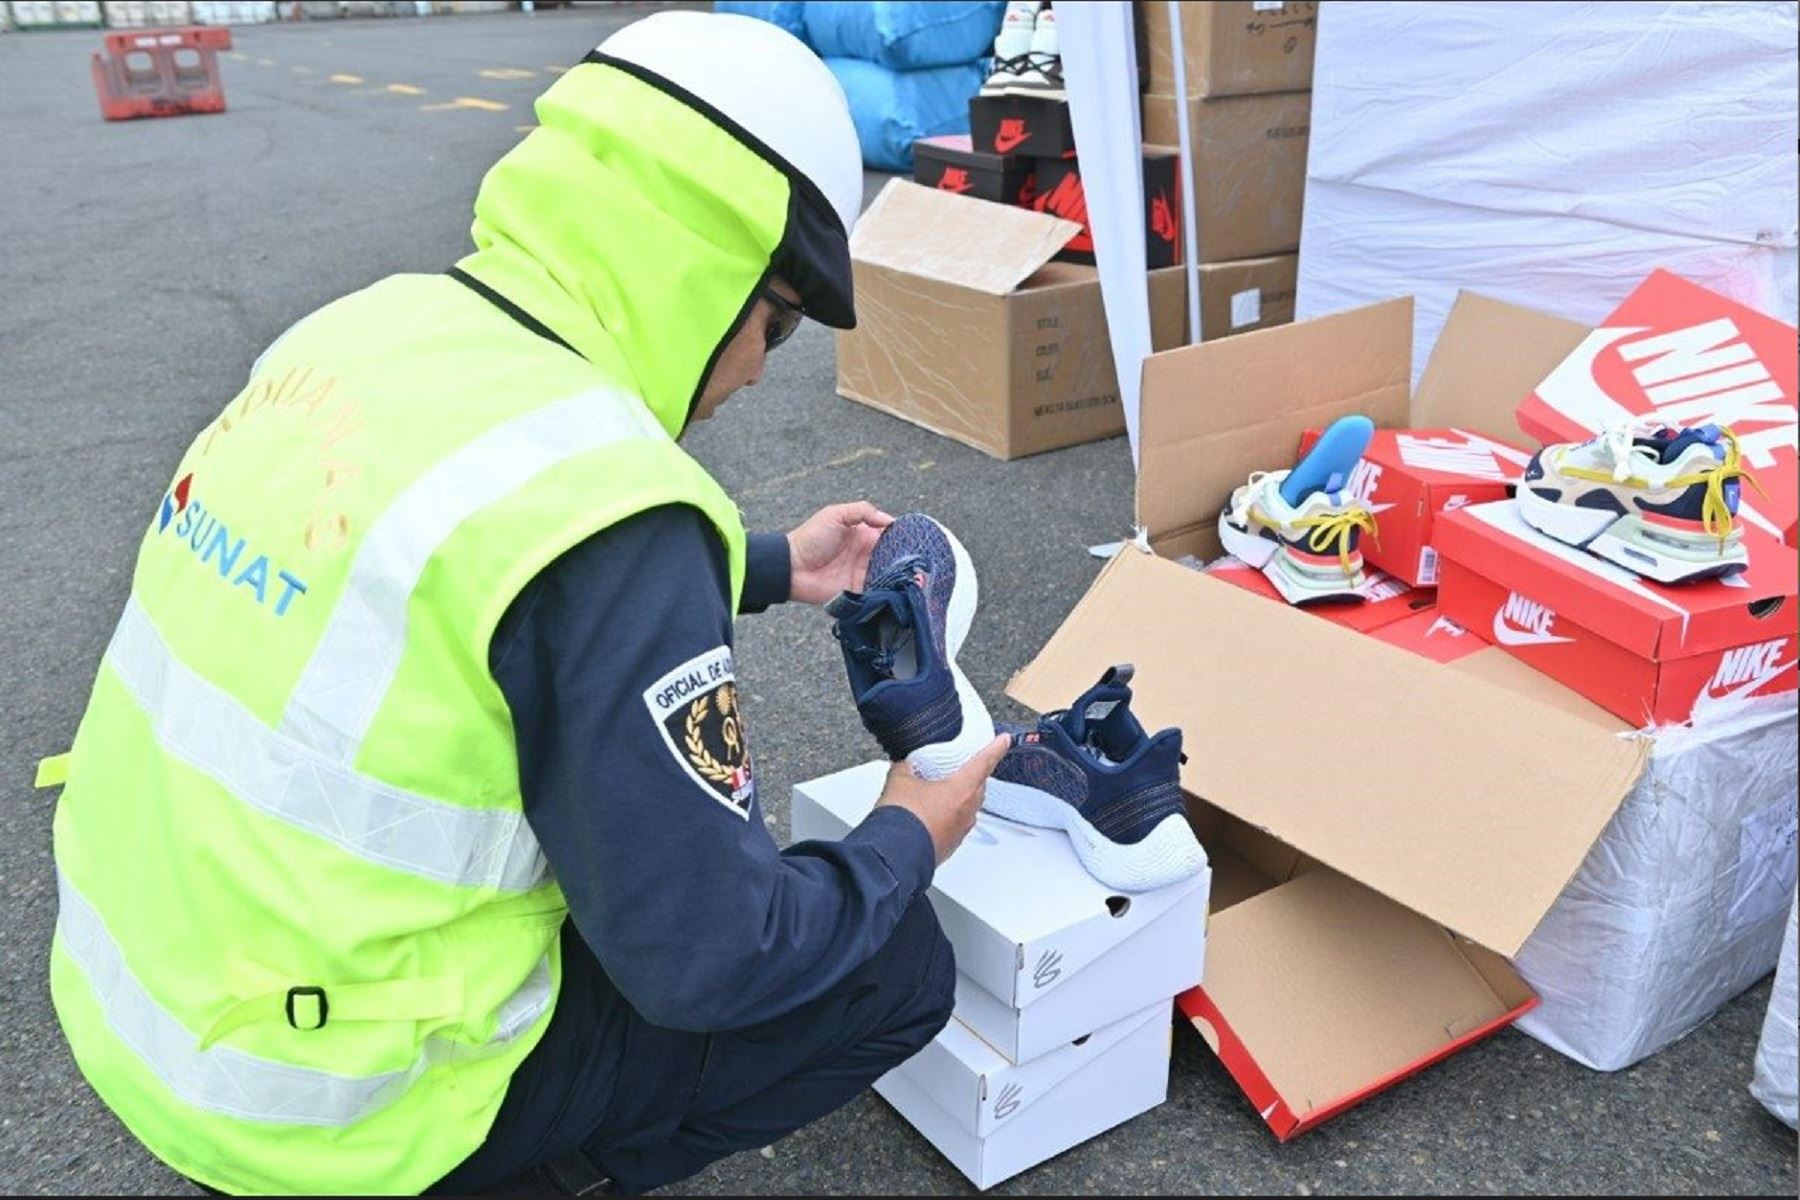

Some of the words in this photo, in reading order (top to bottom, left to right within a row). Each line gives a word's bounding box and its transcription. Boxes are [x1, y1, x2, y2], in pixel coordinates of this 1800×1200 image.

[1616, 316, 1797, 470] NIKE
[176, 501, 307, 616] SUNAT
[1503, 591, 1556, 636] NIKE
[656, 670, 708, 709] OFICIAL
[707, 661, 722, 682] DE
[1709, 638, 1788, 690] NIKE
